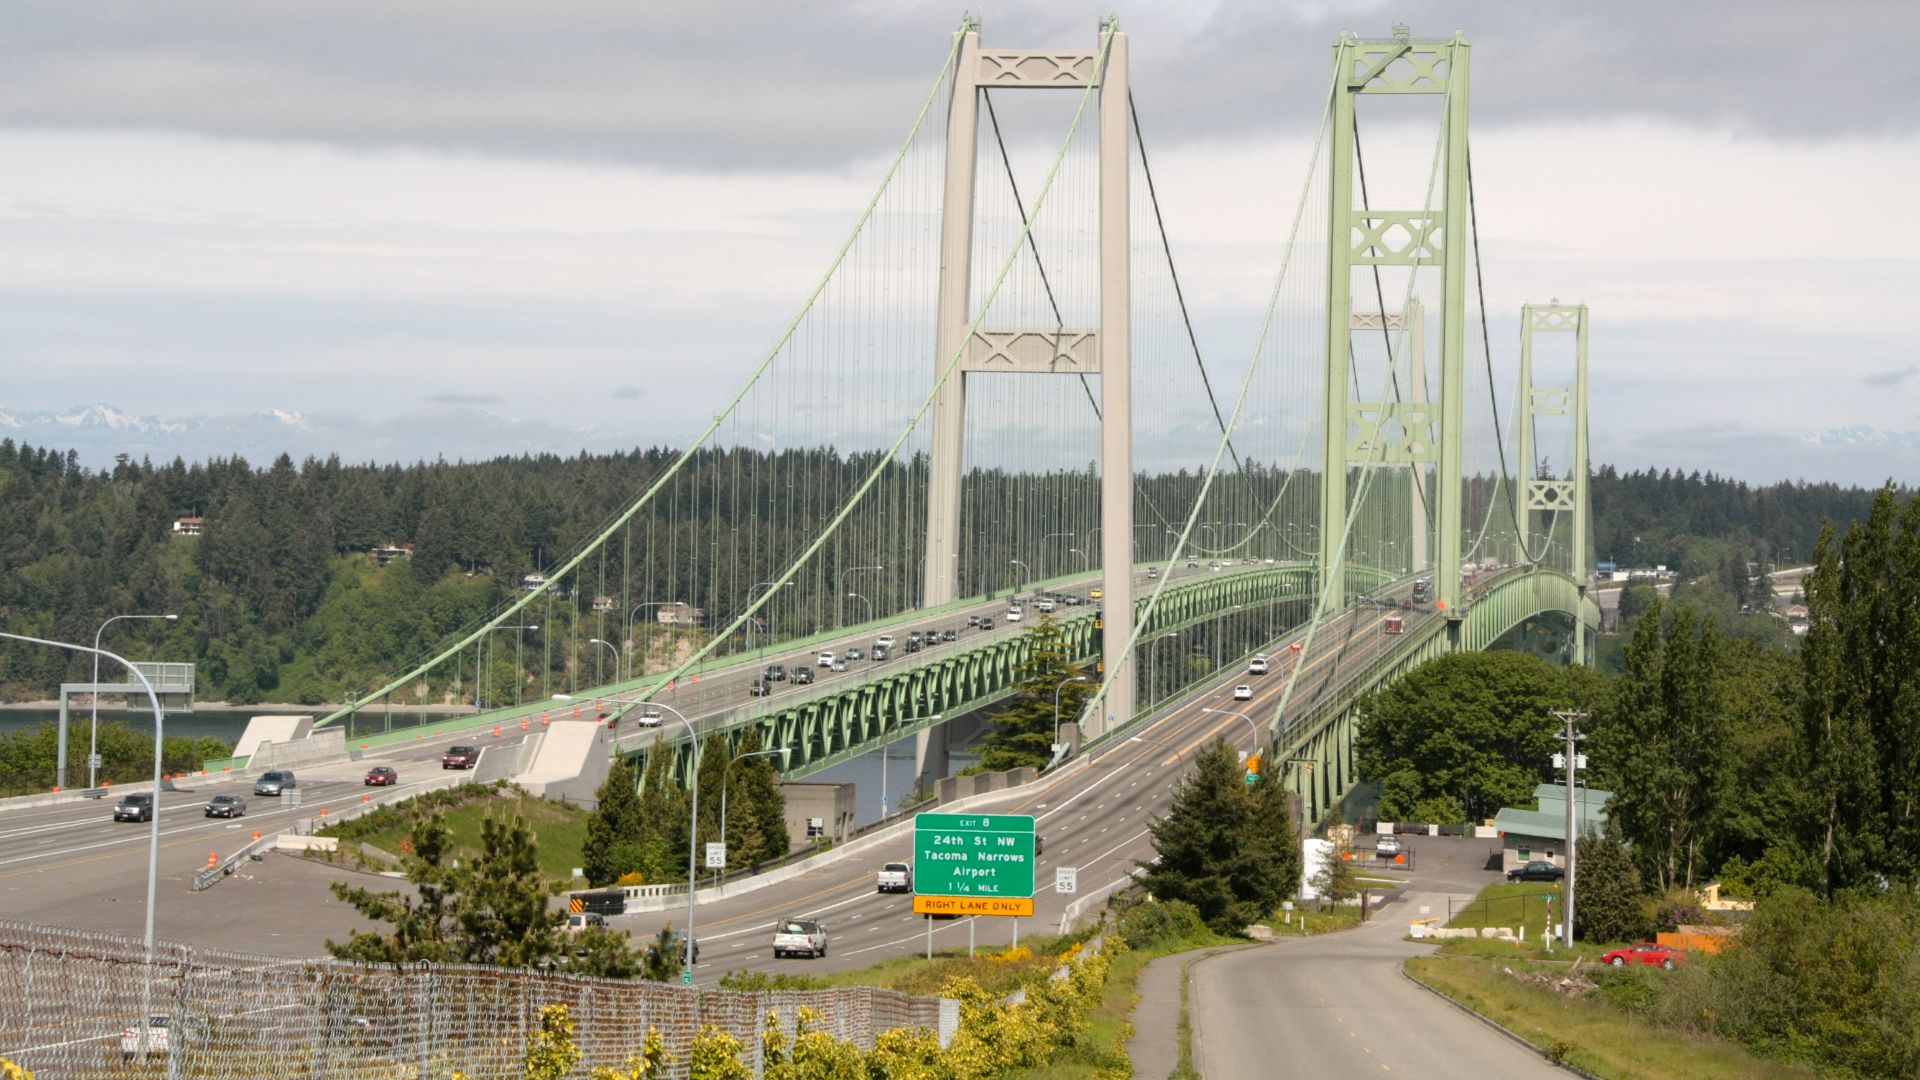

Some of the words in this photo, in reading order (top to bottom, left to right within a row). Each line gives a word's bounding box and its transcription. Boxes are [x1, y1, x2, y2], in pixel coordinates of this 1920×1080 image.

[982, 818, 990, 827] 8
[933, 835, 964, 846] 24th
[974, 836, 988, 846] St
[997, 837, 1016, 847] NW
[709, 856, 722, 865] 55
[924, 850, 968, 861] Tacoma
[977, 851, 1025, 863] Narrows
[953, 866, 996, 879] Airport
[978, 885, 999, 893] MILE
[1059, 882, 1073, 891] 55
[925, 900, 957, 910] RIGHT
[960, 901, 989, 911] LANE
[992, 902, 1022, 911] ONLY
